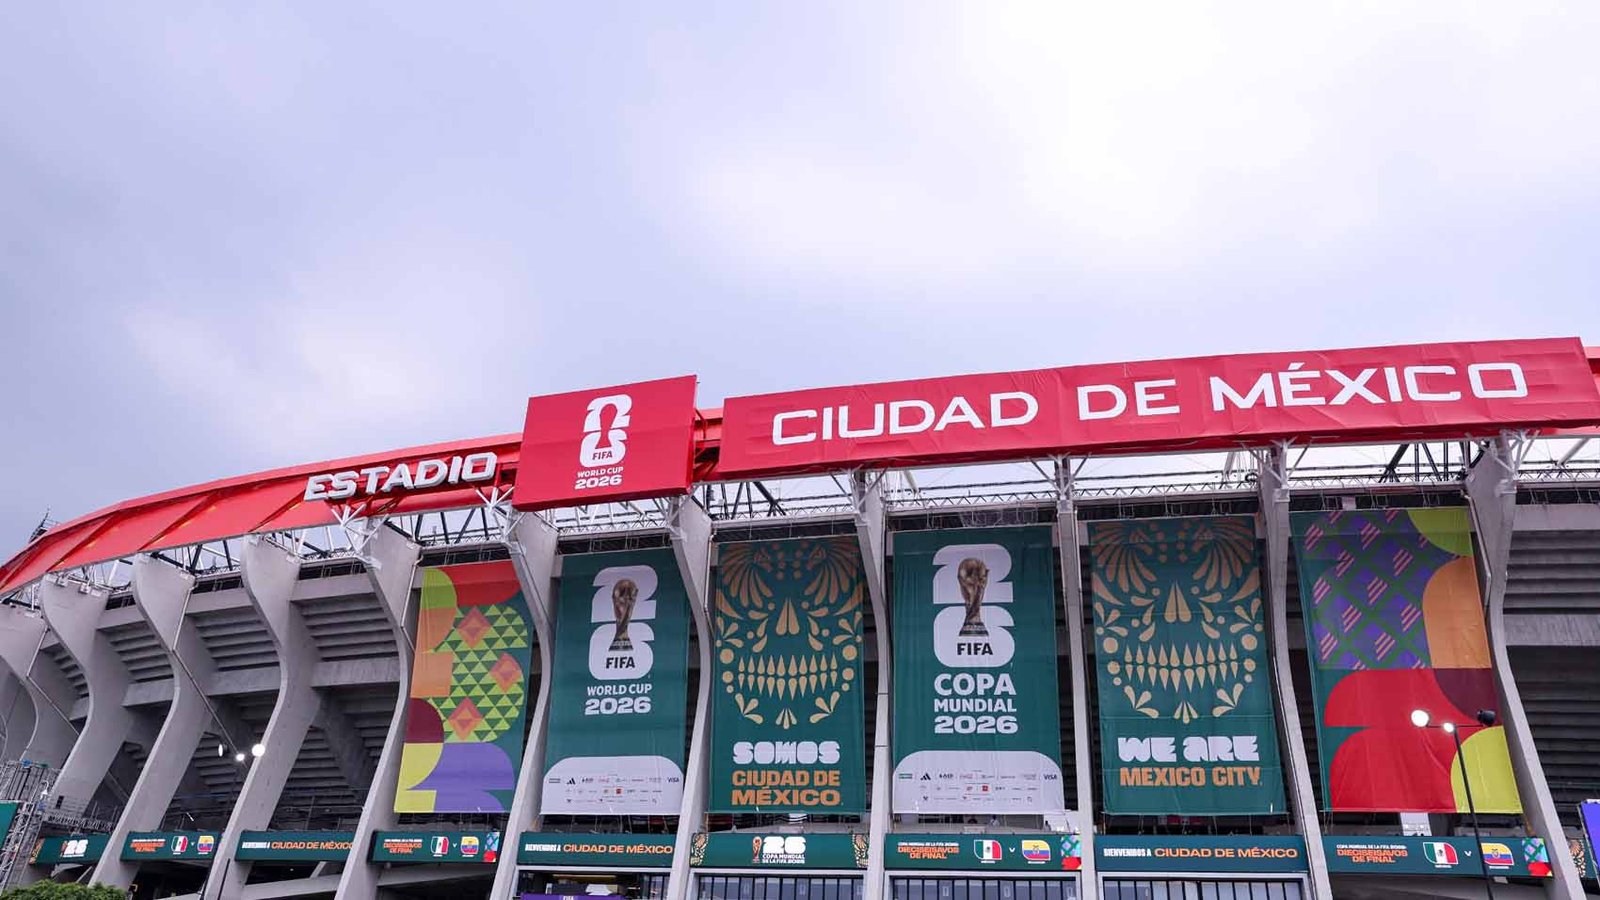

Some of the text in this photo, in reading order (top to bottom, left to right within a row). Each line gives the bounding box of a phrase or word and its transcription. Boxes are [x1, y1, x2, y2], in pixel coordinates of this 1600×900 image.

[772, 362, 1529, 446] CIUDAD DE MÉXICO
[592, 450, 613, 460] FIFA
[303, 451, 498, 501] ESTADIO
[577, 466, 624, 478] WORLD CUP
[574, 474, 622, 490] 2026
[957, 643, 993, 655] FIFA
[605, 656, 635, 669] FIFA
[587, 683, 652, 696] WORLD CUP
[934, 673, 1017, 696] COPA
[584, 696, 652, 715] 2026
[934, 698, 1017, 713] MUNDIAL
[934, 715, 1018, 734] 2026
[732, 741, 841, 765] SOMOS
[1117, 735, 1260, 762] WE ARE
[732, 770, 841, 786] CIUDAD DE
[1119, 766, 1261, 787] MEXICO CITY
[731, 786, 841, 806] MÉXICO
[271, 841, 306, 849] CIUDAD
[306, 841, 320, 849] DE
[563, 843, 607, 853] CIUDAD
[608, 844, 625, 853] DE
[626, 843, 673, 854] MÉXICO
[1103, 846, 1298, 858] BIENVENIDOS A CIUDAD DE MÉXICO
[1337, 849, 1408, 857] DIECISEISAVOS
